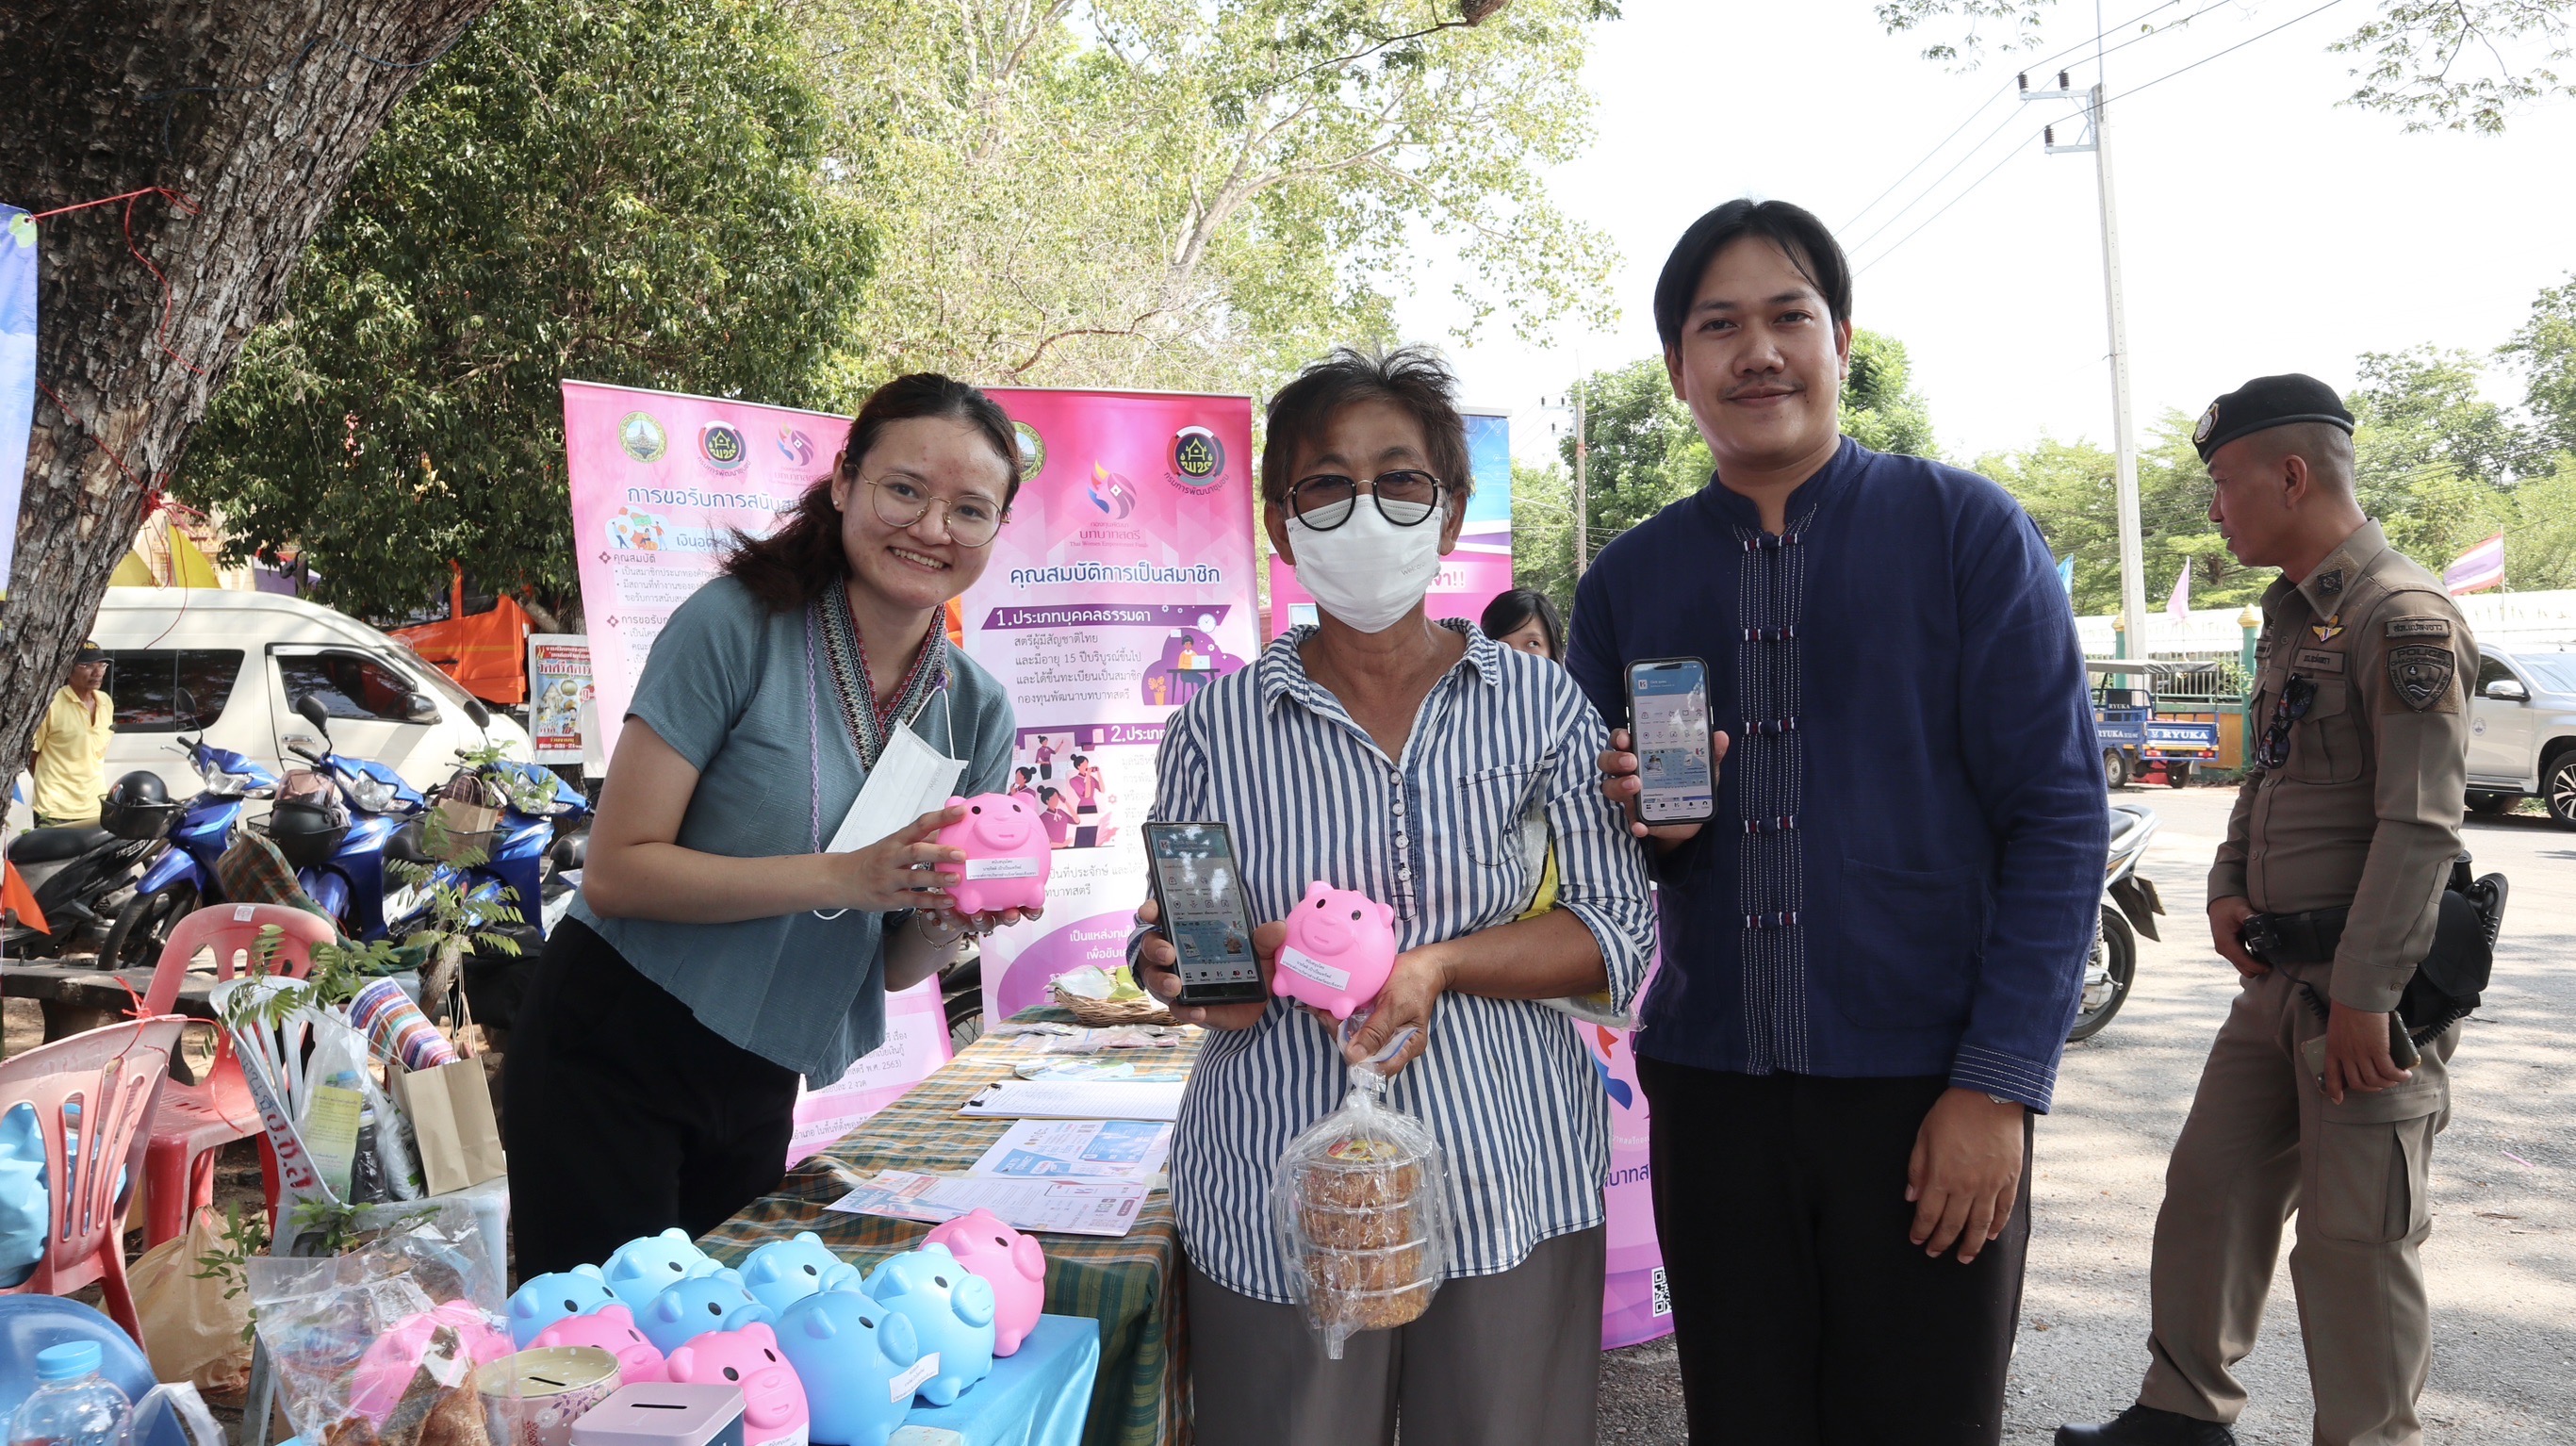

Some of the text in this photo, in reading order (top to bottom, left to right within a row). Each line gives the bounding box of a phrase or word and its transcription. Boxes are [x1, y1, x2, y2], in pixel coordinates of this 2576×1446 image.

[1163, 471, 1230, 496] กรมการพัฒนาชุมชน
[1079, 529, 1141, 541] บทบาทสตรี
[613, 552, 656, 565] คุณสมบัติ
[1009, 561, 1222, 589] คุณสมบัติการเป็นสมาชิก
[996, 609, 1152, 627] 1.ประเภทบุคคลธรรมดา
[1014, 631, 1099, 650] สตรีผู้มีสัญชาติไทย
[1015, 647, 1142, 667] และมีอายุ 15 ปีบริบูรณ์ขึ้นไป
[2396, 648, 2448, 661] POLICE
[1016, 667, 1142, 685] และได้ขึ้นทะเบียนเป็นสมาชิก
[2391, 668, 2416, 705] PROVINCIAL
[1017, 688, 1130, 707] กองทุนพัฒนาบทบาทสตรี
[2162, 731, 2208, 740] RYUKA
[882, 1059, 902, 1072] 2563)
[848, 1081, 854, 1090] 2
